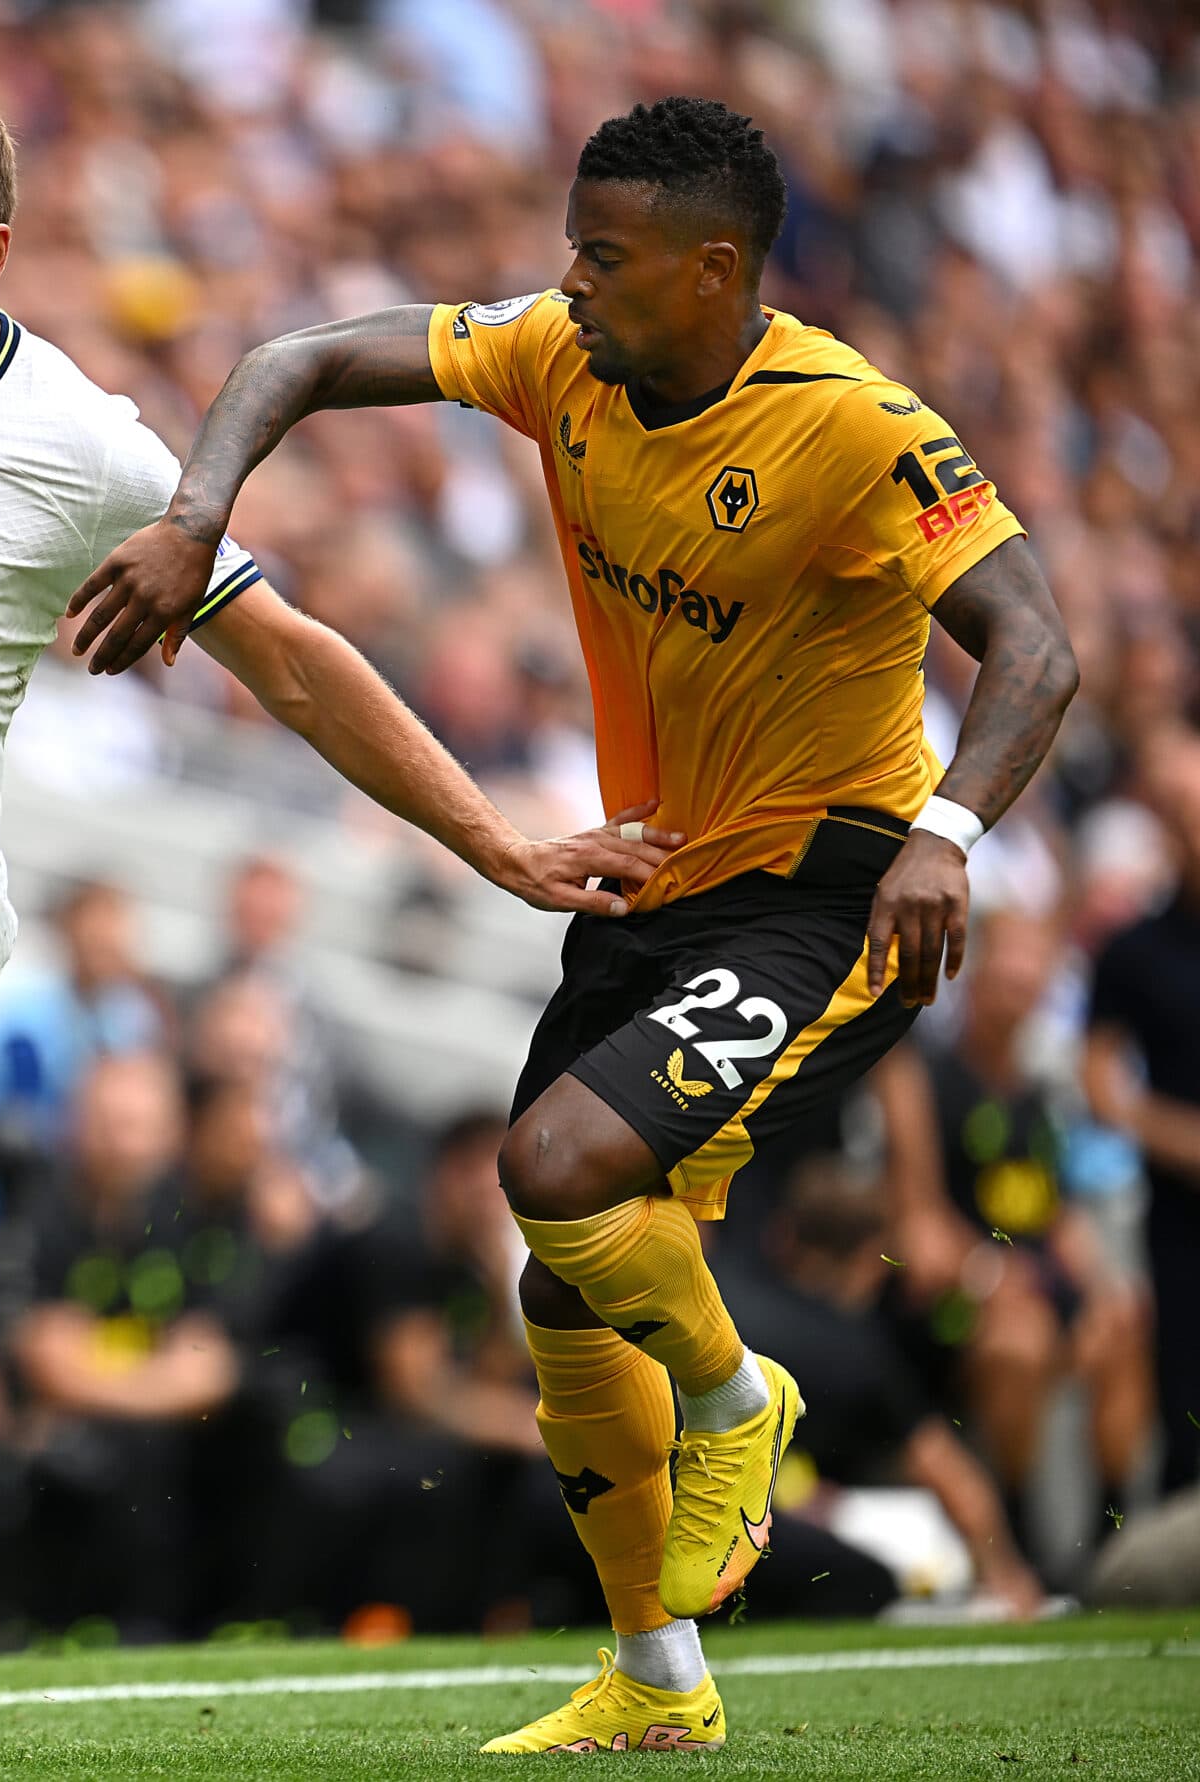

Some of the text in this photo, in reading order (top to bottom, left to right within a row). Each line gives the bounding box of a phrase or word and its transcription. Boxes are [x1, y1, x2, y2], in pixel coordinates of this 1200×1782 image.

[891, 436, 984, 510] 12
[578, 542, 745, 644] stroPay
[646, 967, 788, 1090] 22
[649, 1069, 689, 1112] CASTORE
